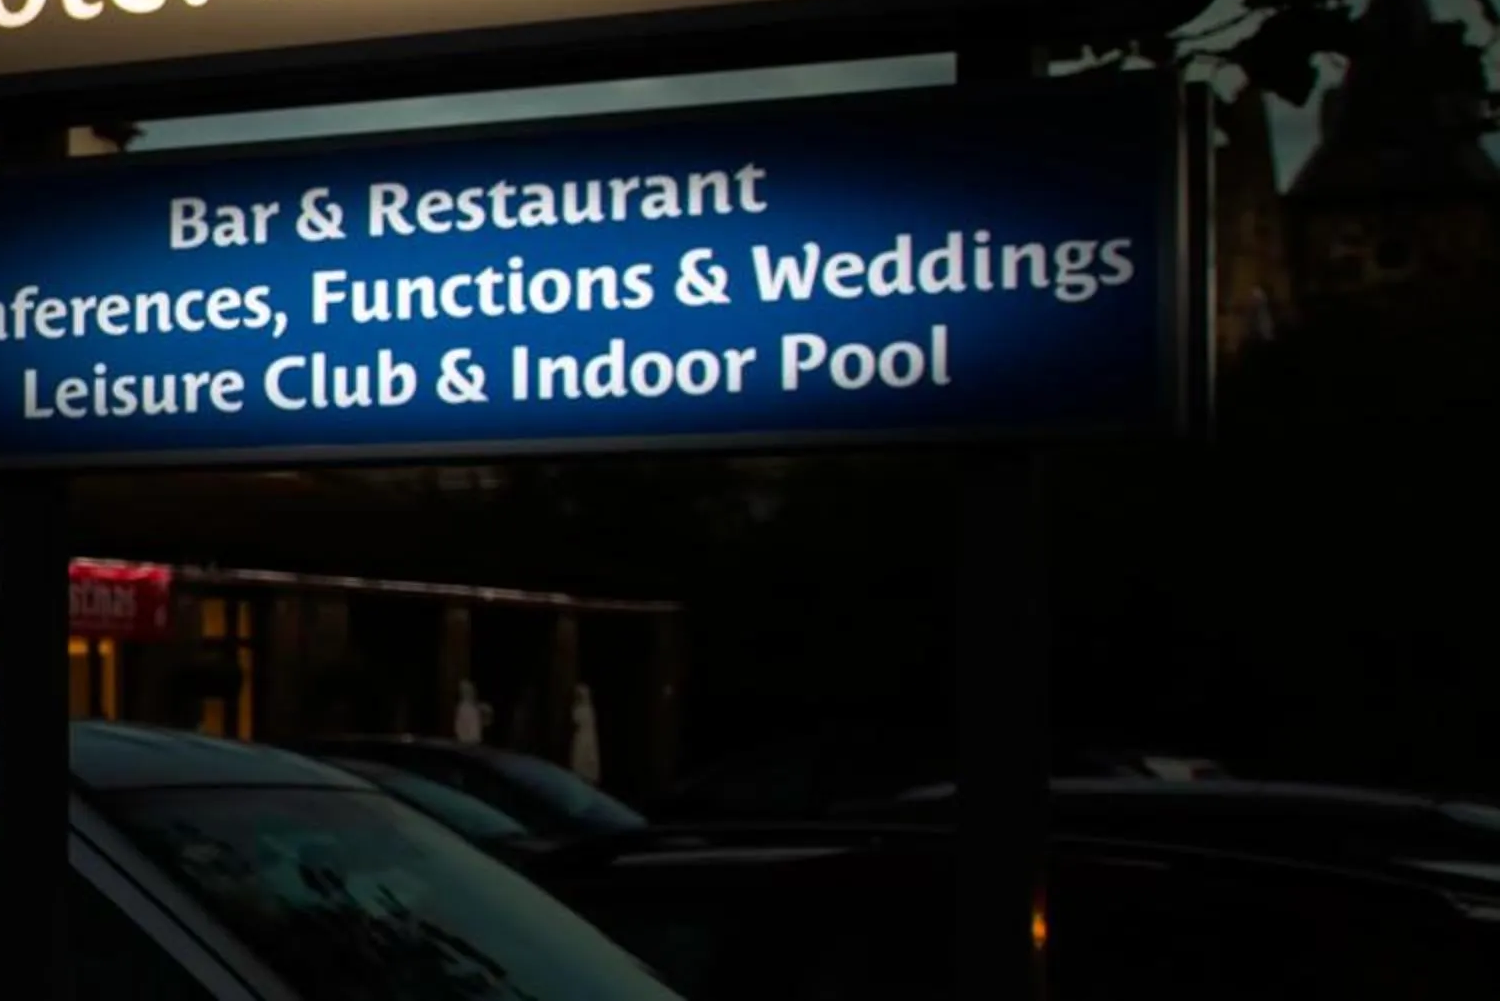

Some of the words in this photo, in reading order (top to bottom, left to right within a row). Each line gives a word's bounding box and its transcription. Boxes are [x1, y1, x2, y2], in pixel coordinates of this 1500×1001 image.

[168, 196, 281, 250] Bar
[295, 187, 348, 243] &
[367, 162, 769, 238] Restaurant
[310, 255, 656, 325] Functions
[674, 246, 733, 308] &
[750, 229, 1135, 303] Weddings
[23, 362, 246, 419] Leisure
[263, 347, 418, 411] Club
[435, 347, 490, 406] &
[511, 337, 758, 401] Indoor
[780, 324, 951, 392] Pool
